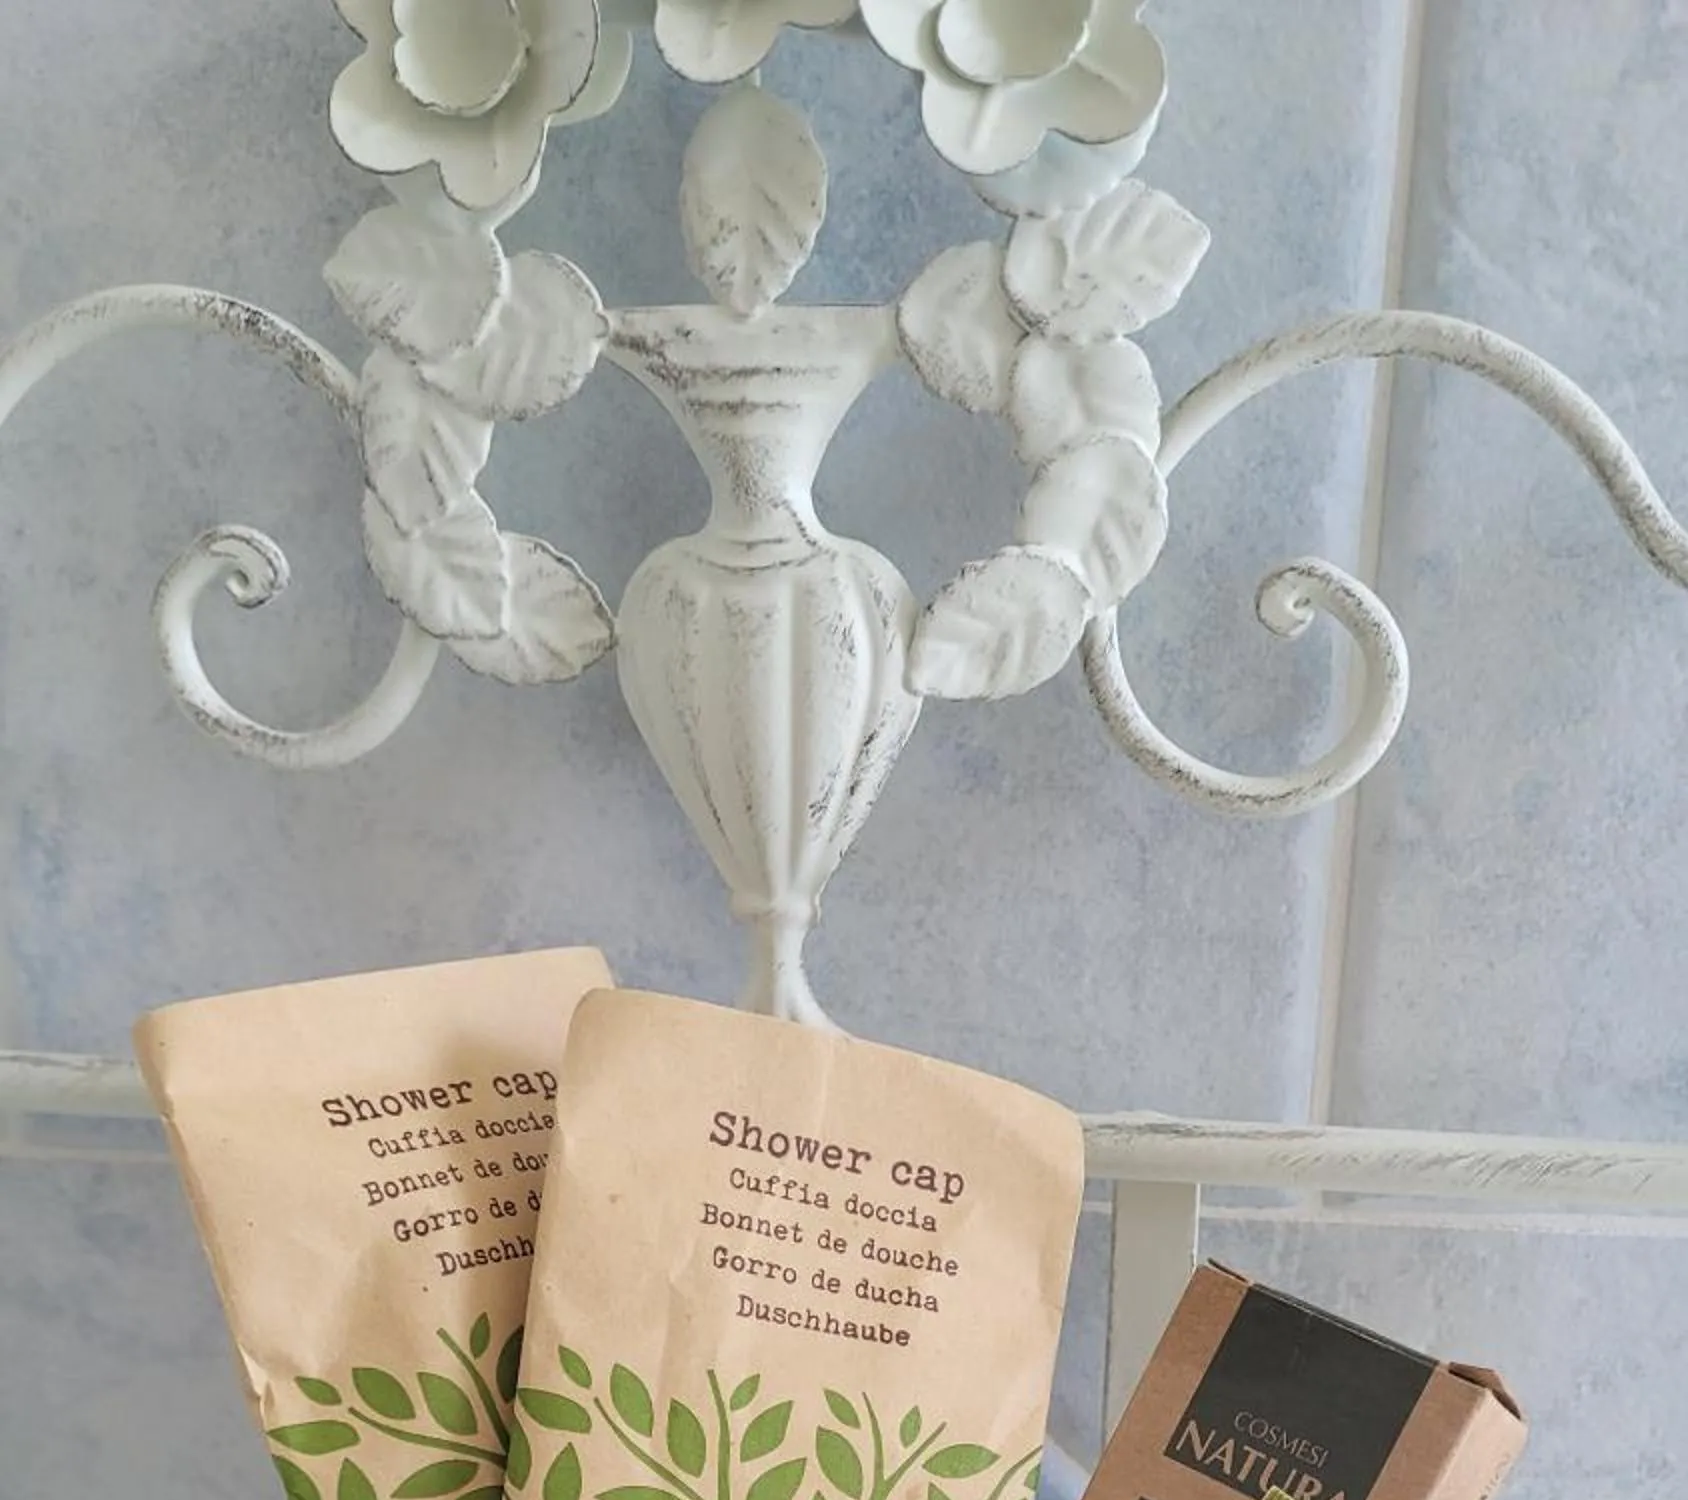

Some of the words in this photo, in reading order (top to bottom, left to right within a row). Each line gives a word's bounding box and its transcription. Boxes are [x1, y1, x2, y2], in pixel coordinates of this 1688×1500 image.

[321, 1079, 473, 1127] Shower
[492, 1070, 558, 1101] cap
[368, 1127, 466, 1158] Cuffia
[475, 1111, 555, 1140] doccia
[709, 1111, 872, 1175] Shower
[891, 1160, 965, 1205] cap
[361, 1163, 464, 1206] Bonnet
[473, 1159, 502, 1178] de
[729, 1167, 830, 1210] Cuffia
[844, 1193, 938, 1232] doccia
[393, 1206, 479, 1242] Gorro
[489, 1198, 518, 1219] de
[700, 1203, 804, 1244] Bonnet
[817, 1229, 847, 1254] de
[861, 1238, 959, 1277] douche
[436, 1235, 535, 1277] Duschh
[712, 1245, 798, 1285] Gorro
[811, 1269, 841, 1294] de
[855, 1278, 940, 1313] ducha
[736, 1294, 911, 1347] Duschhaube
[1233, 1410, 1329, 1469] COSMESI
